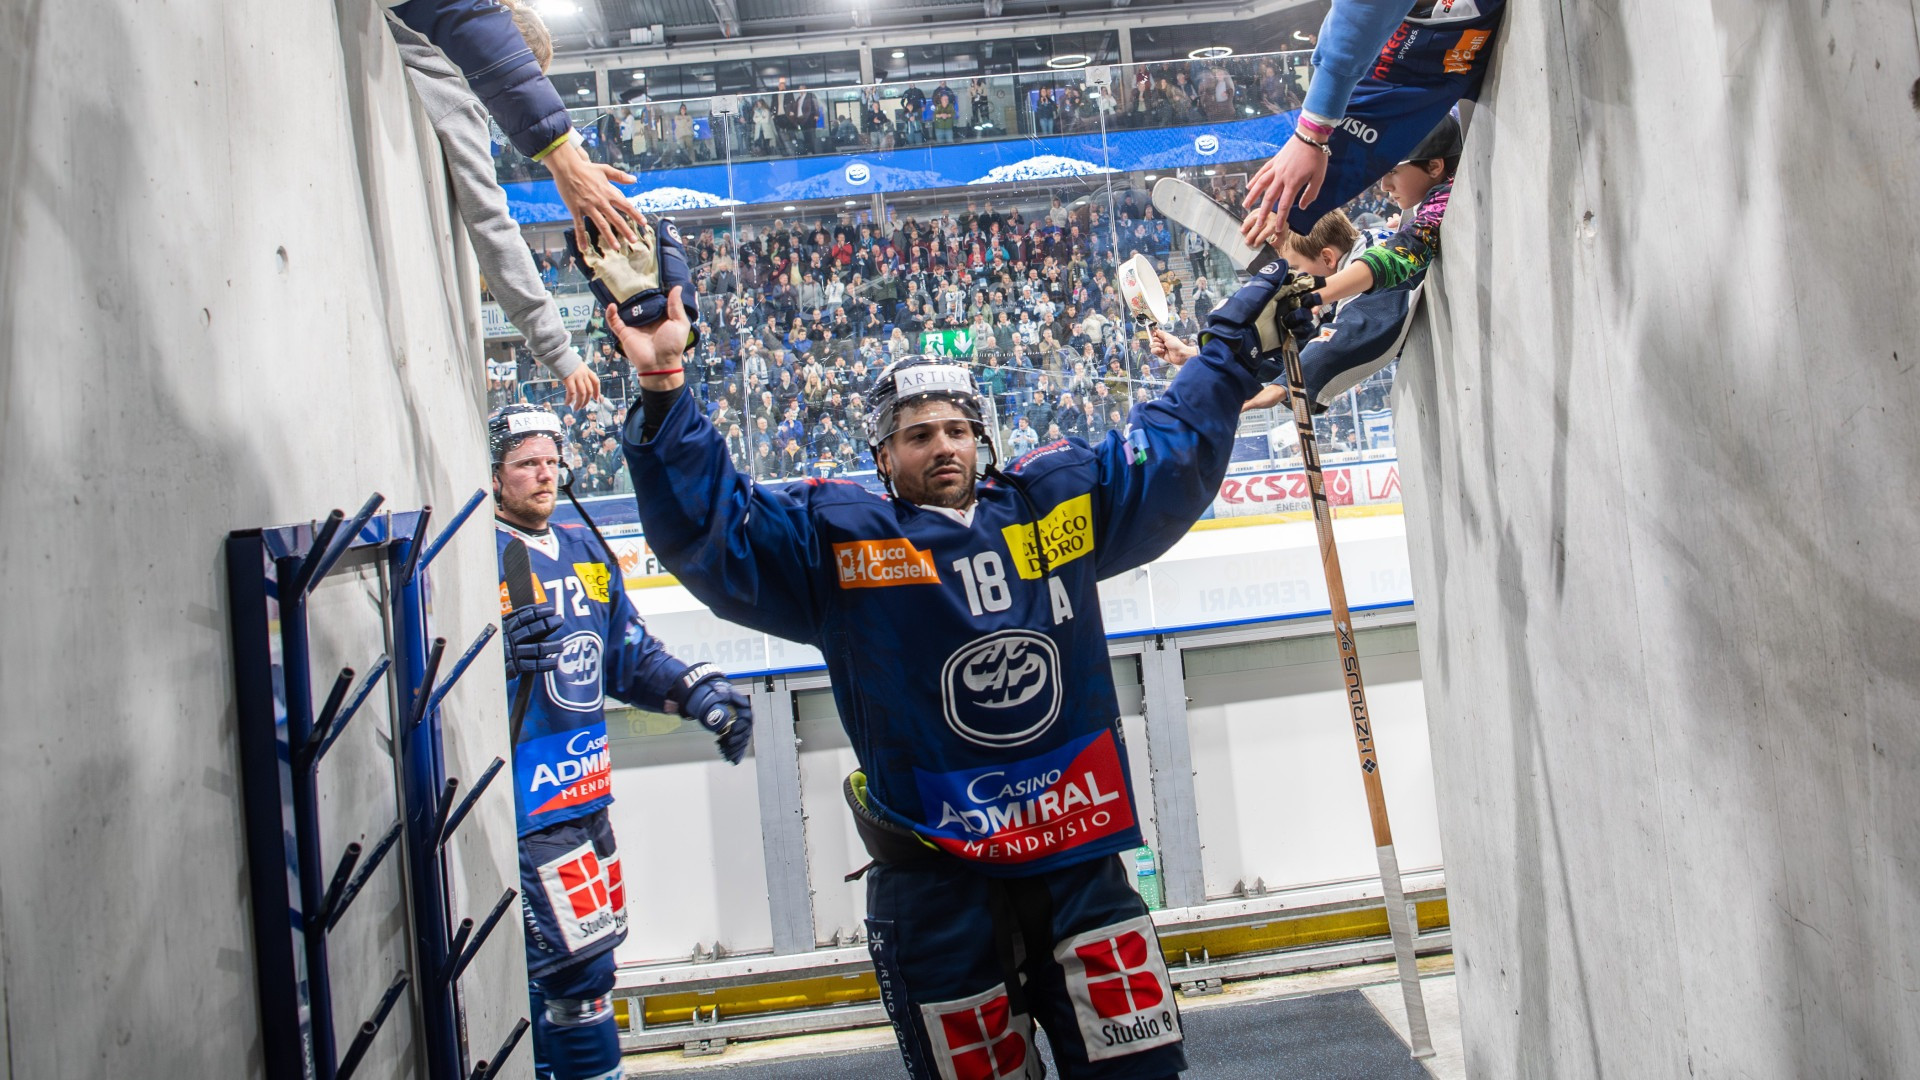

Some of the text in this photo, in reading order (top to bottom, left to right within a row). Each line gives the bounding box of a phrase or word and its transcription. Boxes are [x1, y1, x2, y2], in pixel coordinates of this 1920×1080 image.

[901, 370, 968, 388] ARTISA
[868, 545, 906, 561] Luca
[543, 576, 591, 618] 72
[953, 551, 1012, 616] 18
[1048, 576, 1074, 625] A
[936, 771, 1120, 834] ADMIRAL
[963, 811, 1110, 857] MENDRISIO
[878, 960, 895, 1013] TRENO
[1102, 1015, 1160, 1047] Studio
